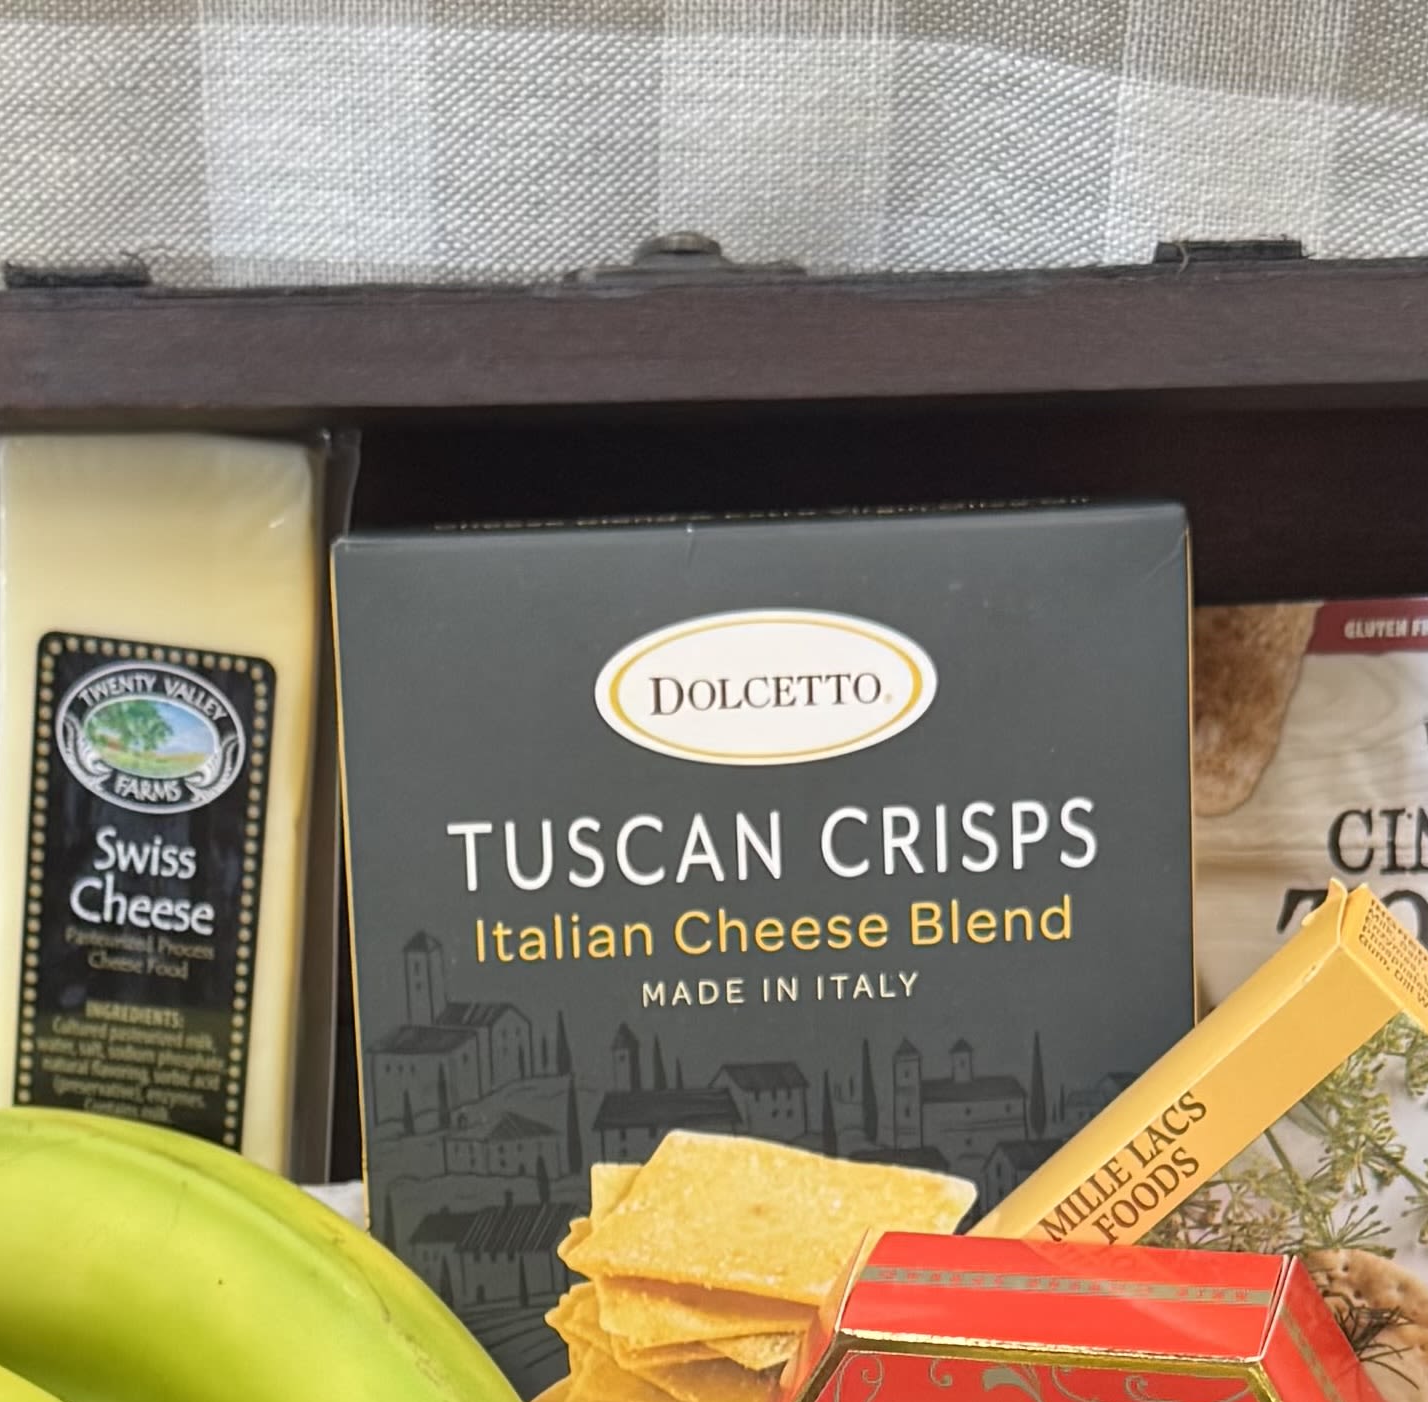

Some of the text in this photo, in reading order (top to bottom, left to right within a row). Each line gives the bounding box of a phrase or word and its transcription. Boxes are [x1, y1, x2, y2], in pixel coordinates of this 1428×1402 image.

[1344, 617, 1406, 641] GLUTEN
[77, 671, 228, 722] TWENTY VALLEY
[649, 672, 881, 716] DOLCETTO
[113, 774, 183, 802] FARMS
[93, 825, 197, 880] Swiss
[446, 796, 1099, 893] TUSCAN CRISPS
[69, 871, 215, 937] Cheese
[475, 893, 1074, 964] Italian Cheese Blend
[642, 970, 920, 1008] MADE IN ITALY
[1038, 1091, 1207, 1242] MILLE LACS
[1092, 1147, 1200, 1245] FOODS
